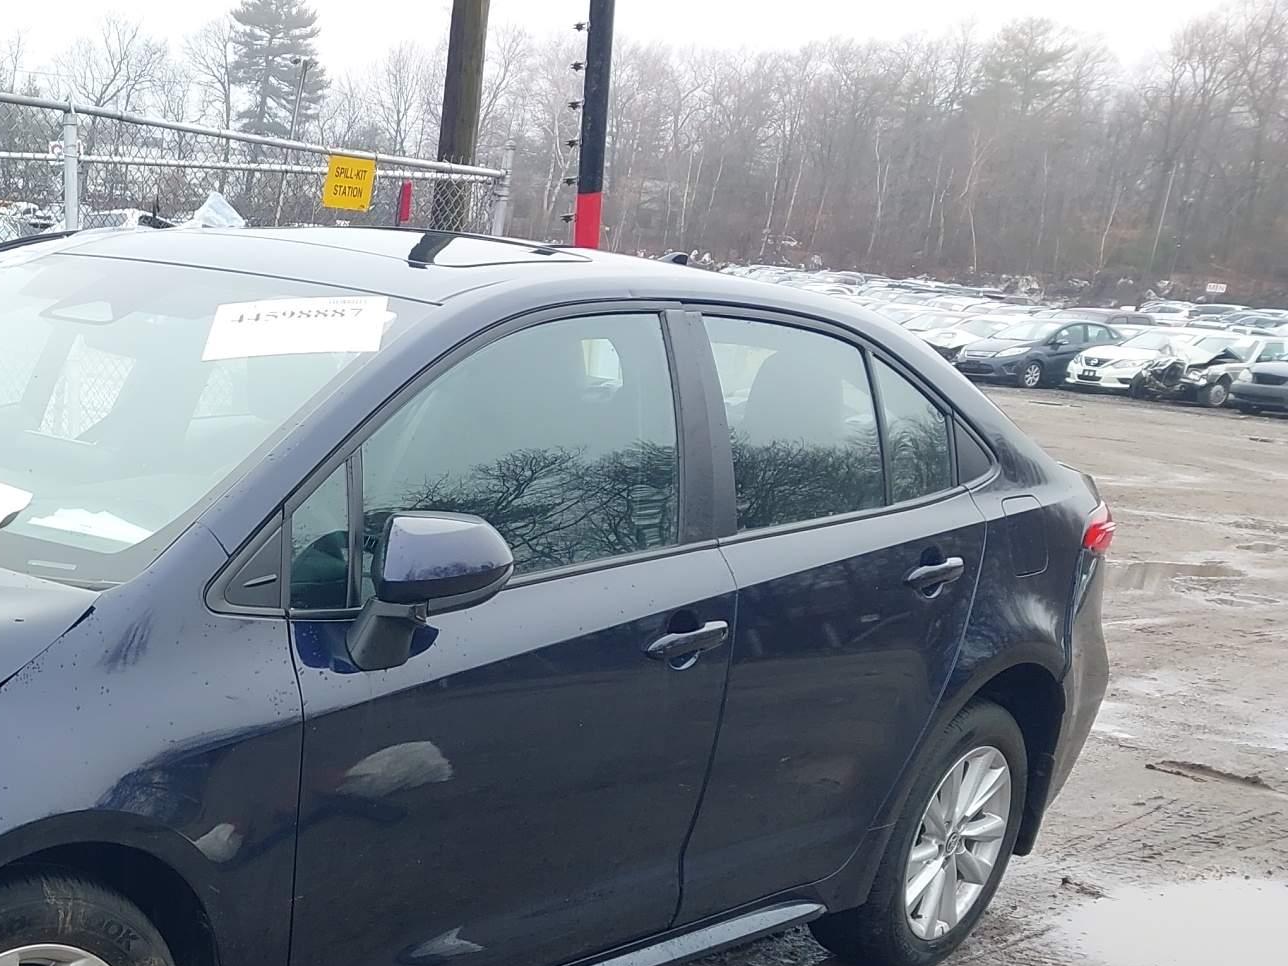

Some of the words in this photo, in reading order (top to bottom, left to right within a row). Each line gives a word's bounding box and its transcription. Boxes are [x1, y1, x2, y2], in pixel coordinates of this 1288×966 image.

[334, 166, 368, 180] SPILL-KIT
[332, 184, 363, 198] STATION
[231, 308, 364, 324] 44598887
